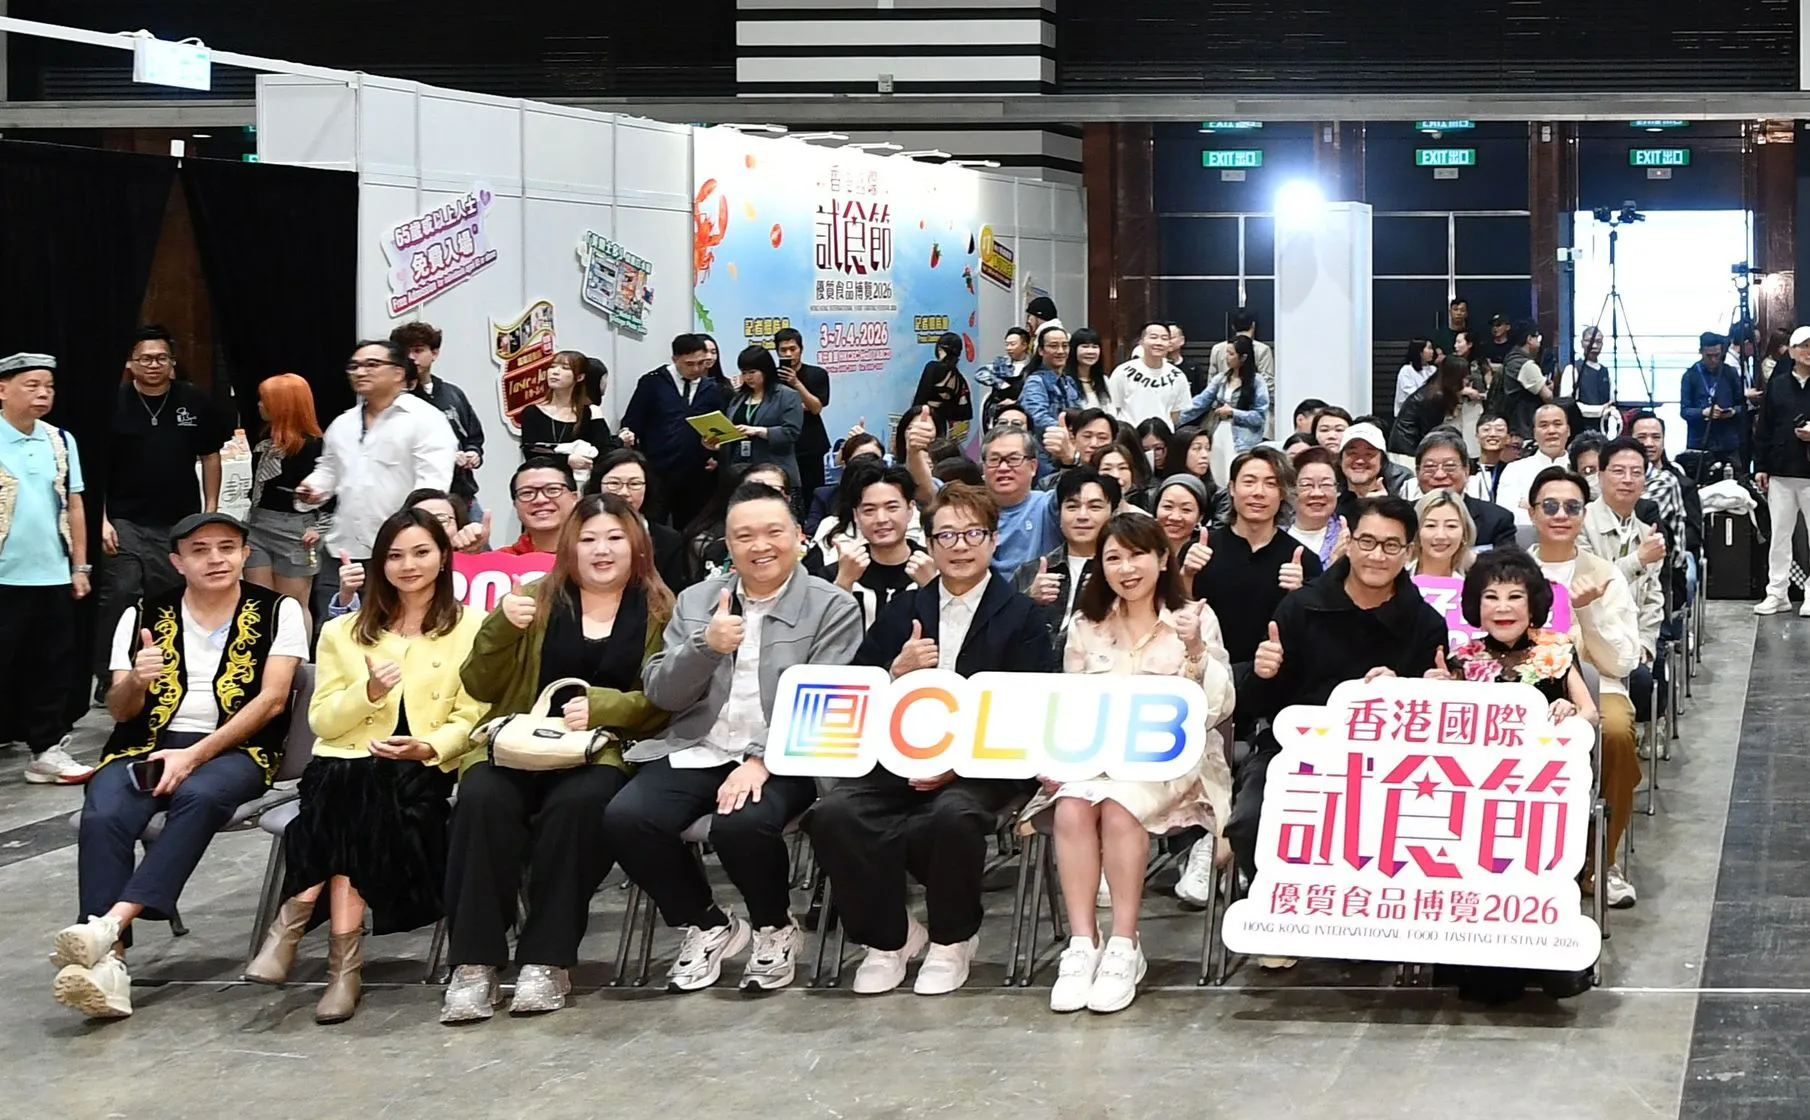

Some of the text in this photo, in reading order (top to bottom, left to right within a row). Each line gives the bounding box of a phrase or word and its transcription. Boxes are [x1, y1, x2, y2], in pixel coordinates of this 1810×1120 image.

[1209, 152, 1234, 166] EXIT
[1422, 150, 1469, 165] EXIT 出口
[1636, 150, 1683, 165] EXIT 出口
[816, 199, 891, 276] 試食節
[816, 280, 892, 300] 優質食品博覽2026
[889, 686, 1190, 764] CLUB
[1345, 697, 1527, 747] 香港國際
[1276, 752, 1571, 880] 試食節
[1270, 882, 1559, 925] 優質食品博覽2026
[1243, 921, 1579, 948] HONG KONG INTERNATIONAL FOOD TASTING FESTIVAL 2026
